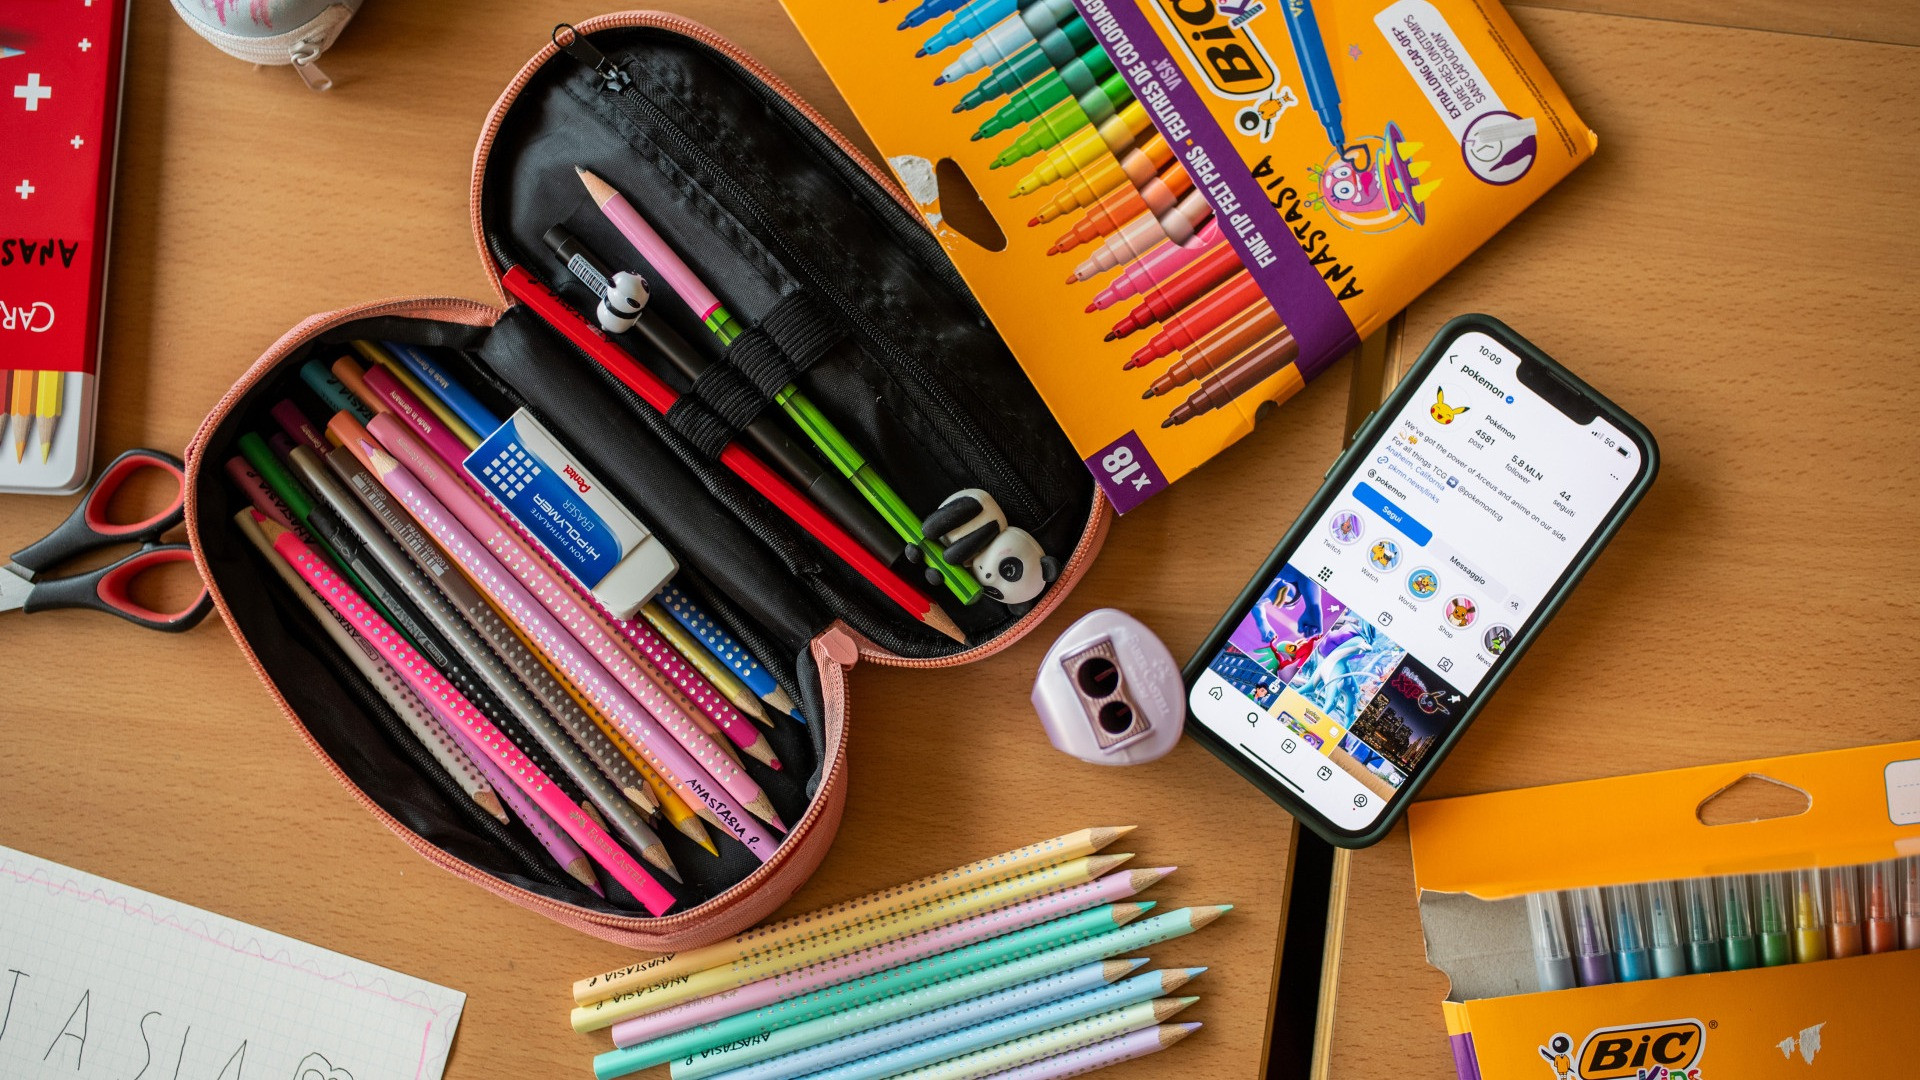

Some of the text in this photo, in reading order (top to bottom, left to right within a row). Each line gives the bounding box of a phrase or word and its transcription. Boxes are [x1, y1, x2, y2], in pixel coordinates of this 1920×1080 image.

[1402, 13, 1444, 66] LONGTEMPS
[1128, 60, 1152, 86] DE
[1419, 64, 1441, 90] LONG
[1435, 88, 1461, 119] EXTRA
[1452, 84, 1475, 111] DURE
[1463, 77, 1486, 104] SANS
[1140, 78, 1190, 142] FEUTRES
[1184, 143, 1220, 185] PENS
[1208, 177, 1241, 216] FELT
[1229, 208, 1255, 238] TIP
[1251, 155, 1364, 301] ANASTASIA
[1244, 230, 1276, 269] FINE
[0, 300, 55, 333] CAR
[1477, 344, 1502, 366] 10:09
[432, 372, 450, 389] Made
[1460, 363, 1506, 399] pokemon
[388, 389, 414, 414] Germany
[415, 416, 432, 433] Made
[1473, 427, 1496, 446] 4581
[1484, 414, 1517, 441] Pokémon
[1467, 436, 1484, 452] post
[1603, 436, 1616, 449] 5G
[560, 463, 591, 495] Pentel
[1102, 446, 1152, 492] x18
[1383, 444, 1446, 492] Anaheim, California
[1390, 435, 1504, 522] For all things TCG @pokemontcg
[1402, 419, 1568, 542] We've got the power of Arceus and anime on our side
[1503, 462, 1531, 485] follower
[1509, 454, 1544, 481] 5.8 MLN
[356, 468, 387, 502] GERMANY
[1374, 474, 1408, 501] pokemon
[1387, 462, 1441, 504] pkmn.news/links
[1558, 489, 1572, 502] 44
[561, 498, 595, 532] ERASER
[1380, 504, 1403, 524] Segui
[1551, 497, 1576, 518] seguiti
[529, 506, 586, 563] NON PHTHALATE
[1321, 538, 1343, 556] Twitch
[1359, 566, 1380, 584] Watch
[1448, 554, 1487, 586] Messaggio
[1396, 594, 1419, 613] Worlds
[1436, 624, 1454, 640] Shop
[1474, 652, 1493, 668] News
[604, 952, 677, 982] ANASTASIA
[699, 1030, 772, 1059] ANASTASIA
[1588, 1031, 1696, 1072] BiC
